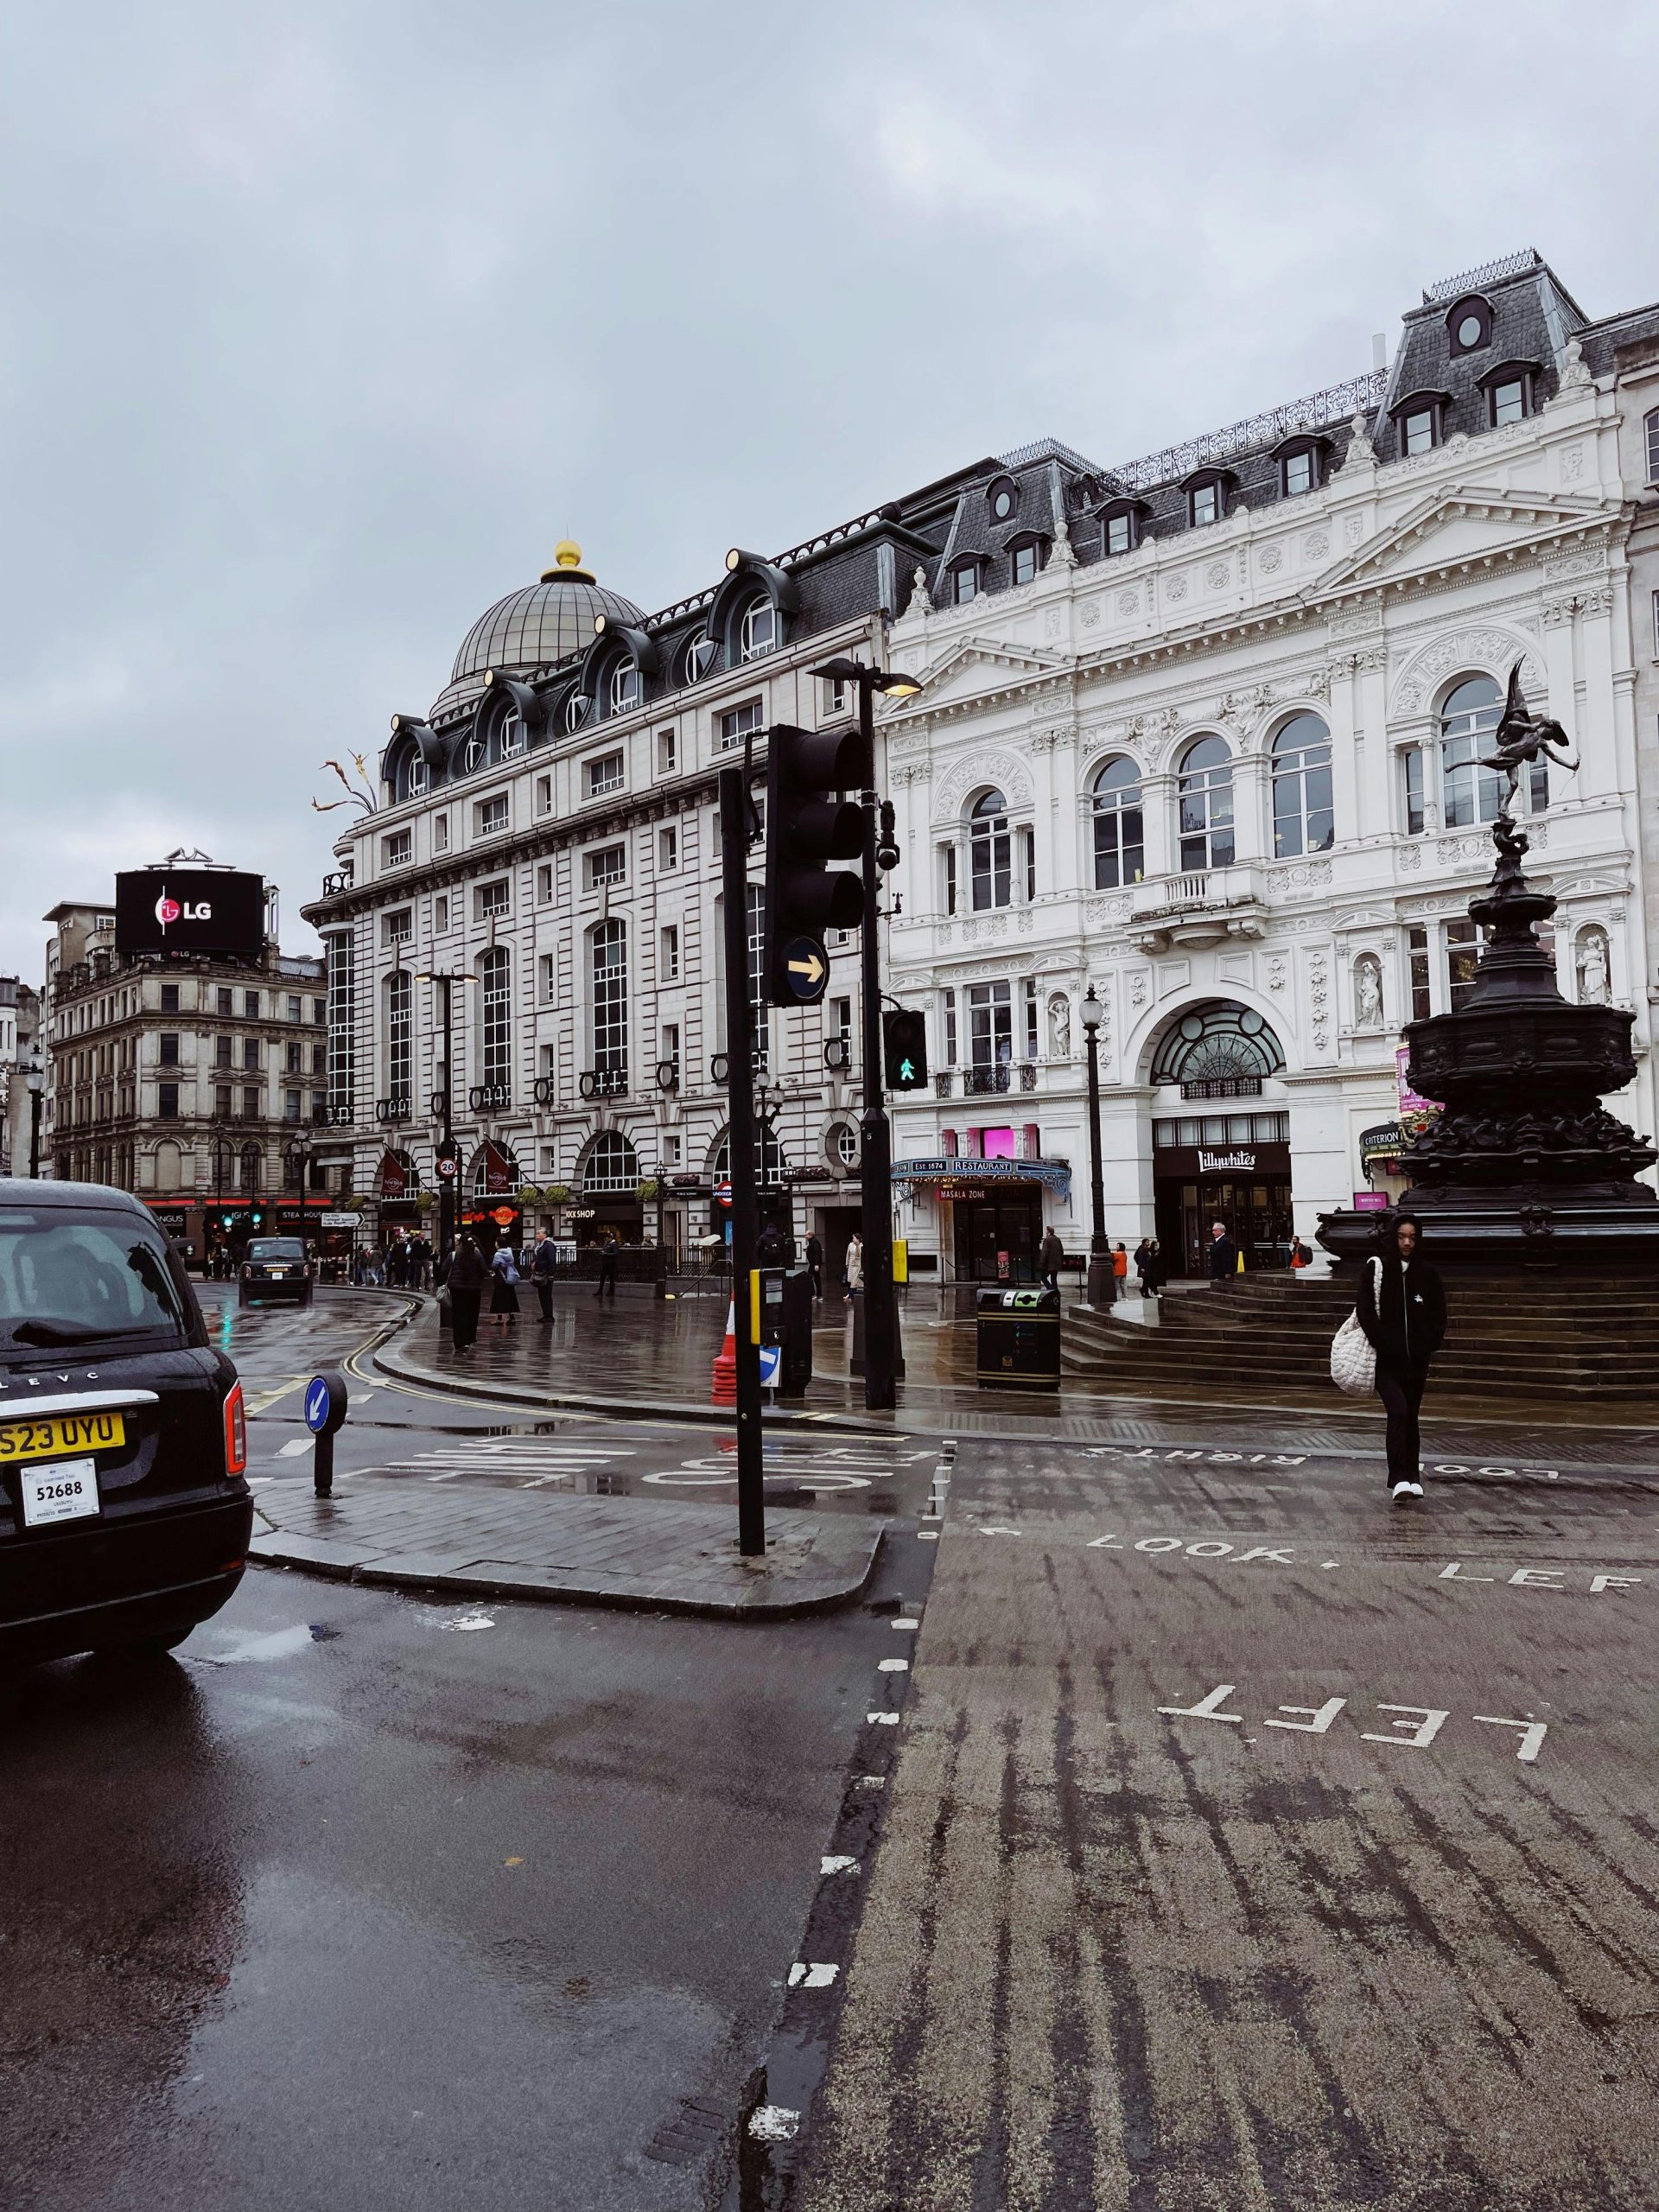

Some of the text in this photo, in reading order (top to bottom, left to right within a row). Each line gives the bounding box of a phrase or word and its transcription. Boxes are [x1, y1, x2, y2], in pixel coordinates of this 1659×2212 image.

[183, 902, 212, 919] LG
[1365, 1131, 1399, 1145] CRITERION
[955, 1161, 1009, 1171] RESTAURANT
[1198, 1150, 1256, 1173] Lillywhites
[969, 1190, 985, 1198] ZONE
[576, 1210, 595, 1218] SHOP
[0, 1416, 113, 1454] S23 UYU
[1124, 1447, 1559, 1480] LOO RIGHT
[37, 1481, 82, 1501] 52688
[1086, 1534, 1295, 1564] LOOK
[1156, 1684, 1548, 1761] LEFT
